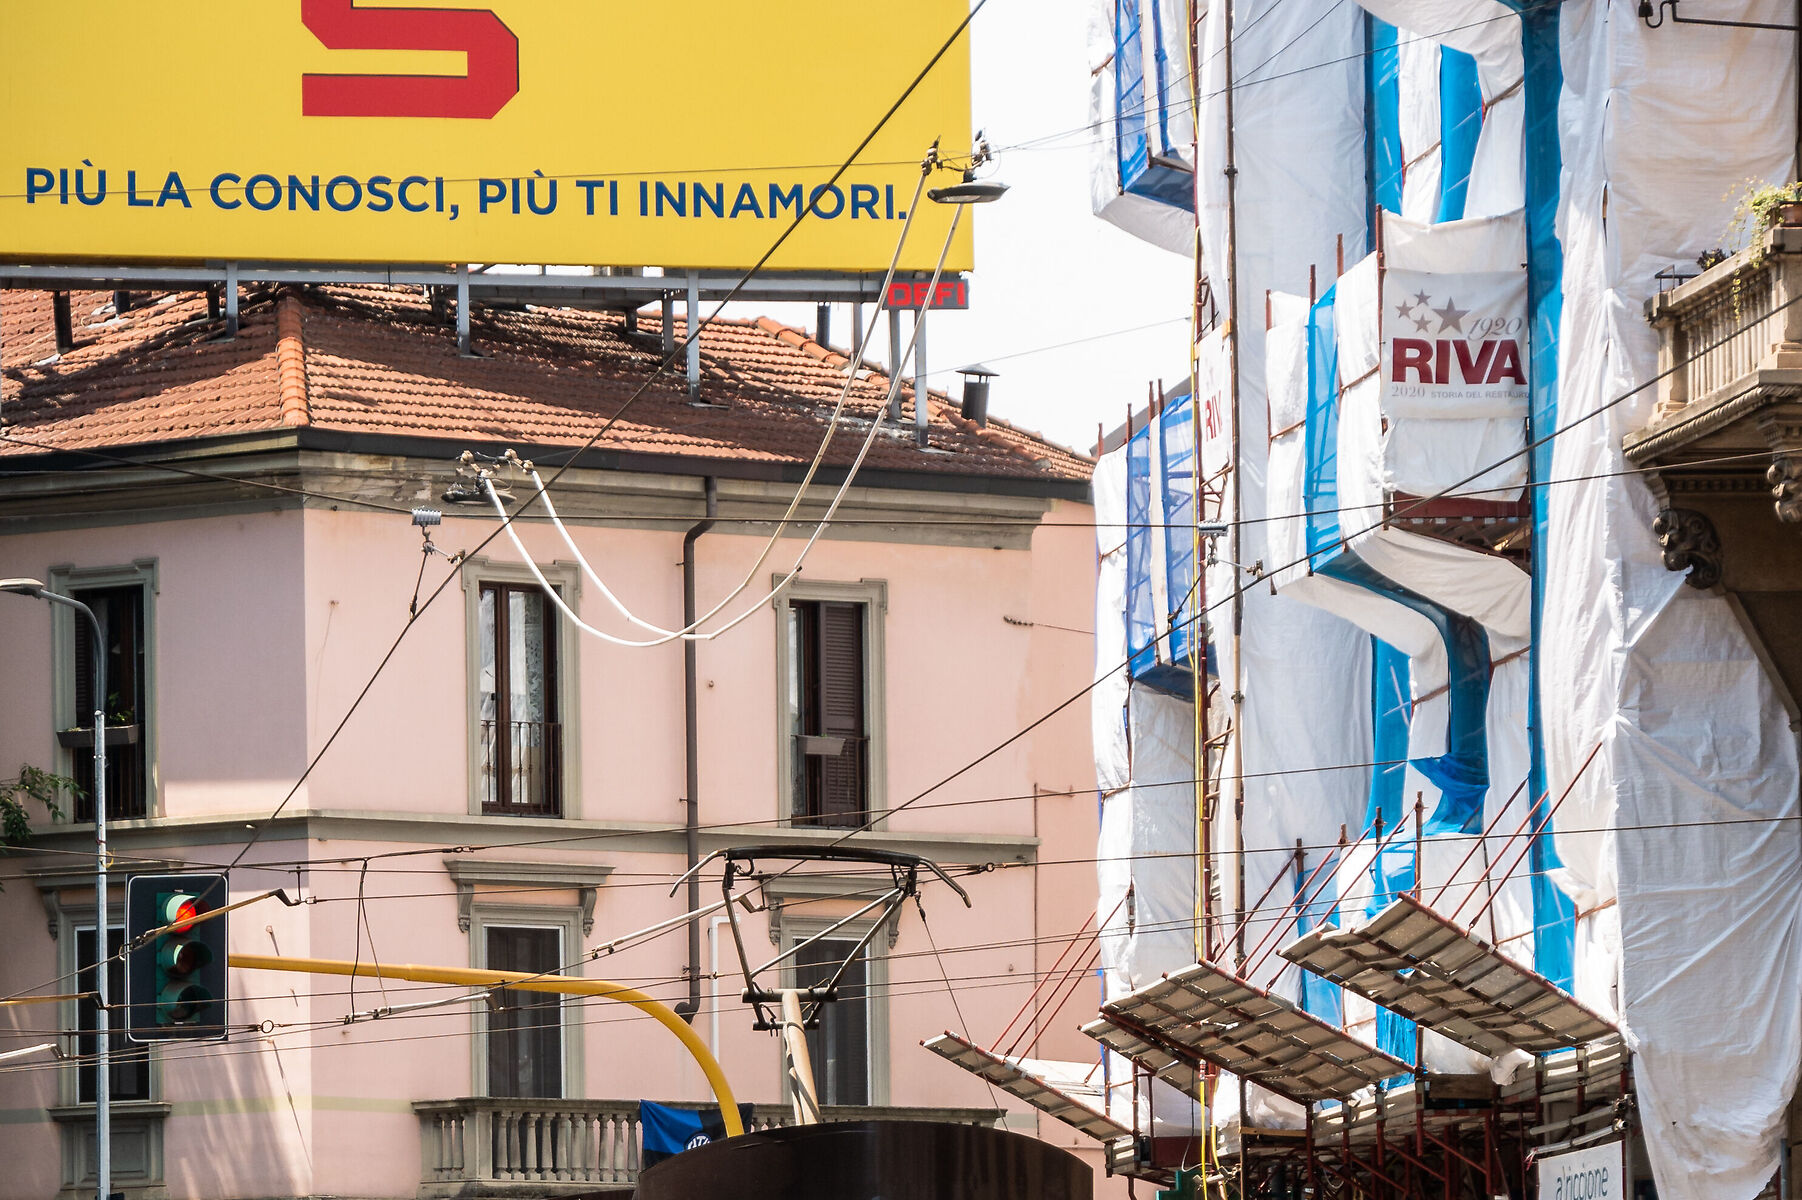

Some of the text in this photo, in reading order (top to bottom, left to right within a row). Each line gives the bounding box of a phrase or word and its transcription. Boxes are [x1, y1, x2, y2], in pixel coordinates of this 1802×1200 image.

[26, 158, 907, 221] PIÙ LA CONOSCI, PIÙ TI INNAMORI.
[887, 282, 965, 307] DEFI
[1467, 316, 1523, 341] 1920
[1391, 337, 1528, 385] RIVA
[1391, 385, 1426, 398] 2020
[1431, 390, 1463, 399] STORIA
[1466, 390, 1483, 399] DEL
